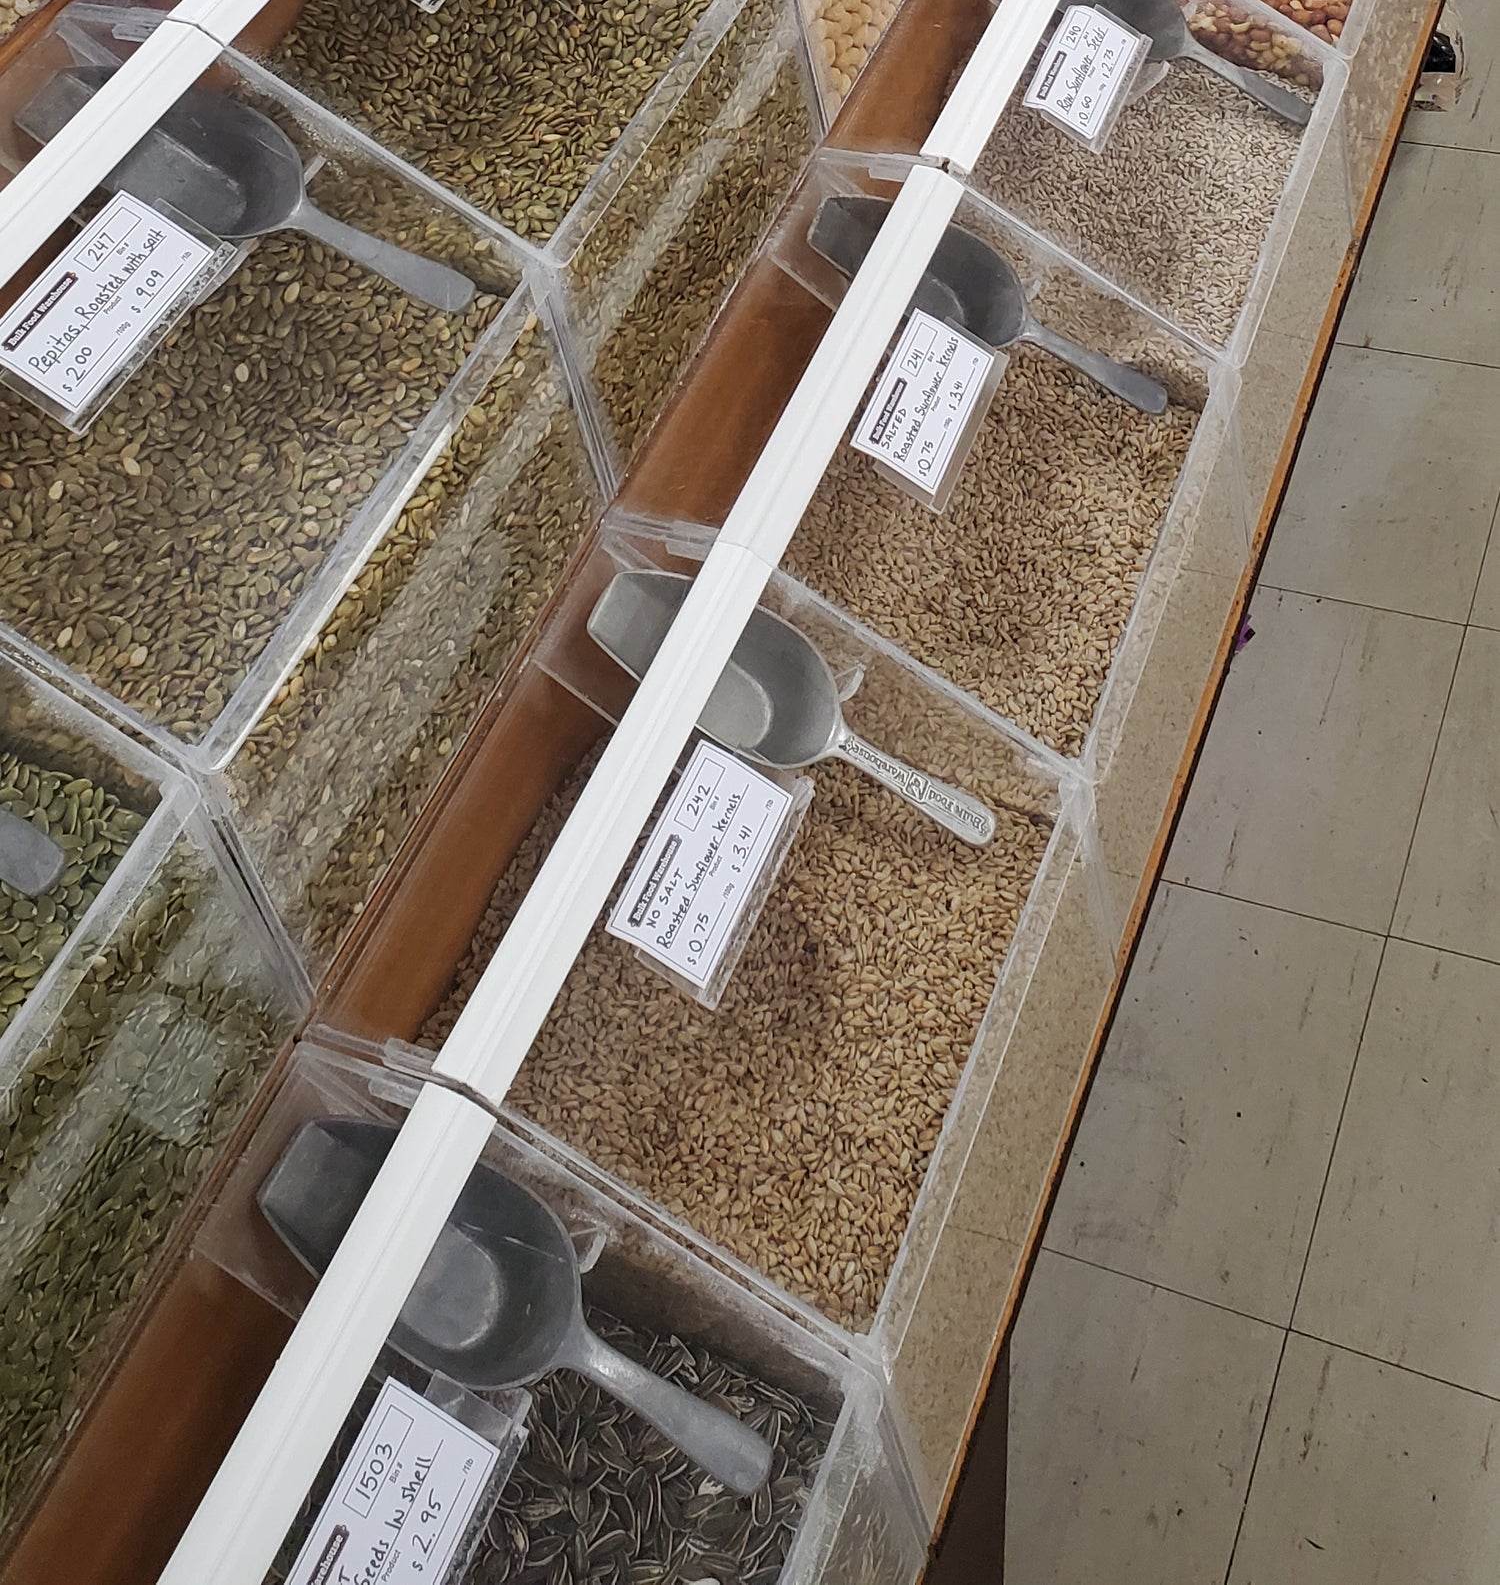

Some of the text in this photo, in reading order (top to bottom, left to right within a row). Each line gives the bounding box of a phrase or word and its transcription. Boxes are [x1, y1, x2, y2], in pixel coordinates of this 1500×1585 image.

[1065, 25, 1081, 43] 240
[1055, 26, 1107, 112] Raw Sunflower Seeds
[87, 231, 115, 261] 247
[115, 246, 125, 255] Bin
[7, 276, 72, 347] Bulk Food Warehouse
[27, 323, 90, 374] Pepitas,
[74, 273, 125, 320] Roasted
[121, 252, 145, 274] with
[102, 295, 122, 314] Product
[906, 348, 924, 369] 241
[880, 408, 906, 450] SALTED
[892, 418, 921, 462] Roasted
[913, 371, 942, 416] Sunflower
[852, 743, 909, 786] Warehouse
[686, 784, 711, 816] 242
[928, 789, 954, 812] Food
[632, 840, 678, 921] Bulk Food Warehouse
[708, 854, 722, 877] Product
[645, 867, 682, 928] NO SALT
[655, 895, 690, 949] Roasted
[684, 835, 719, 891] Sunflower
[354, 1443, 392, 1500] 1503
[388, 1468, 400, 1483] Bin
[411, 1487, 441, 1554] 2.95
[461, 1457, 473, 1474] /1lb
[380, 1548, 401, 1582] Product
